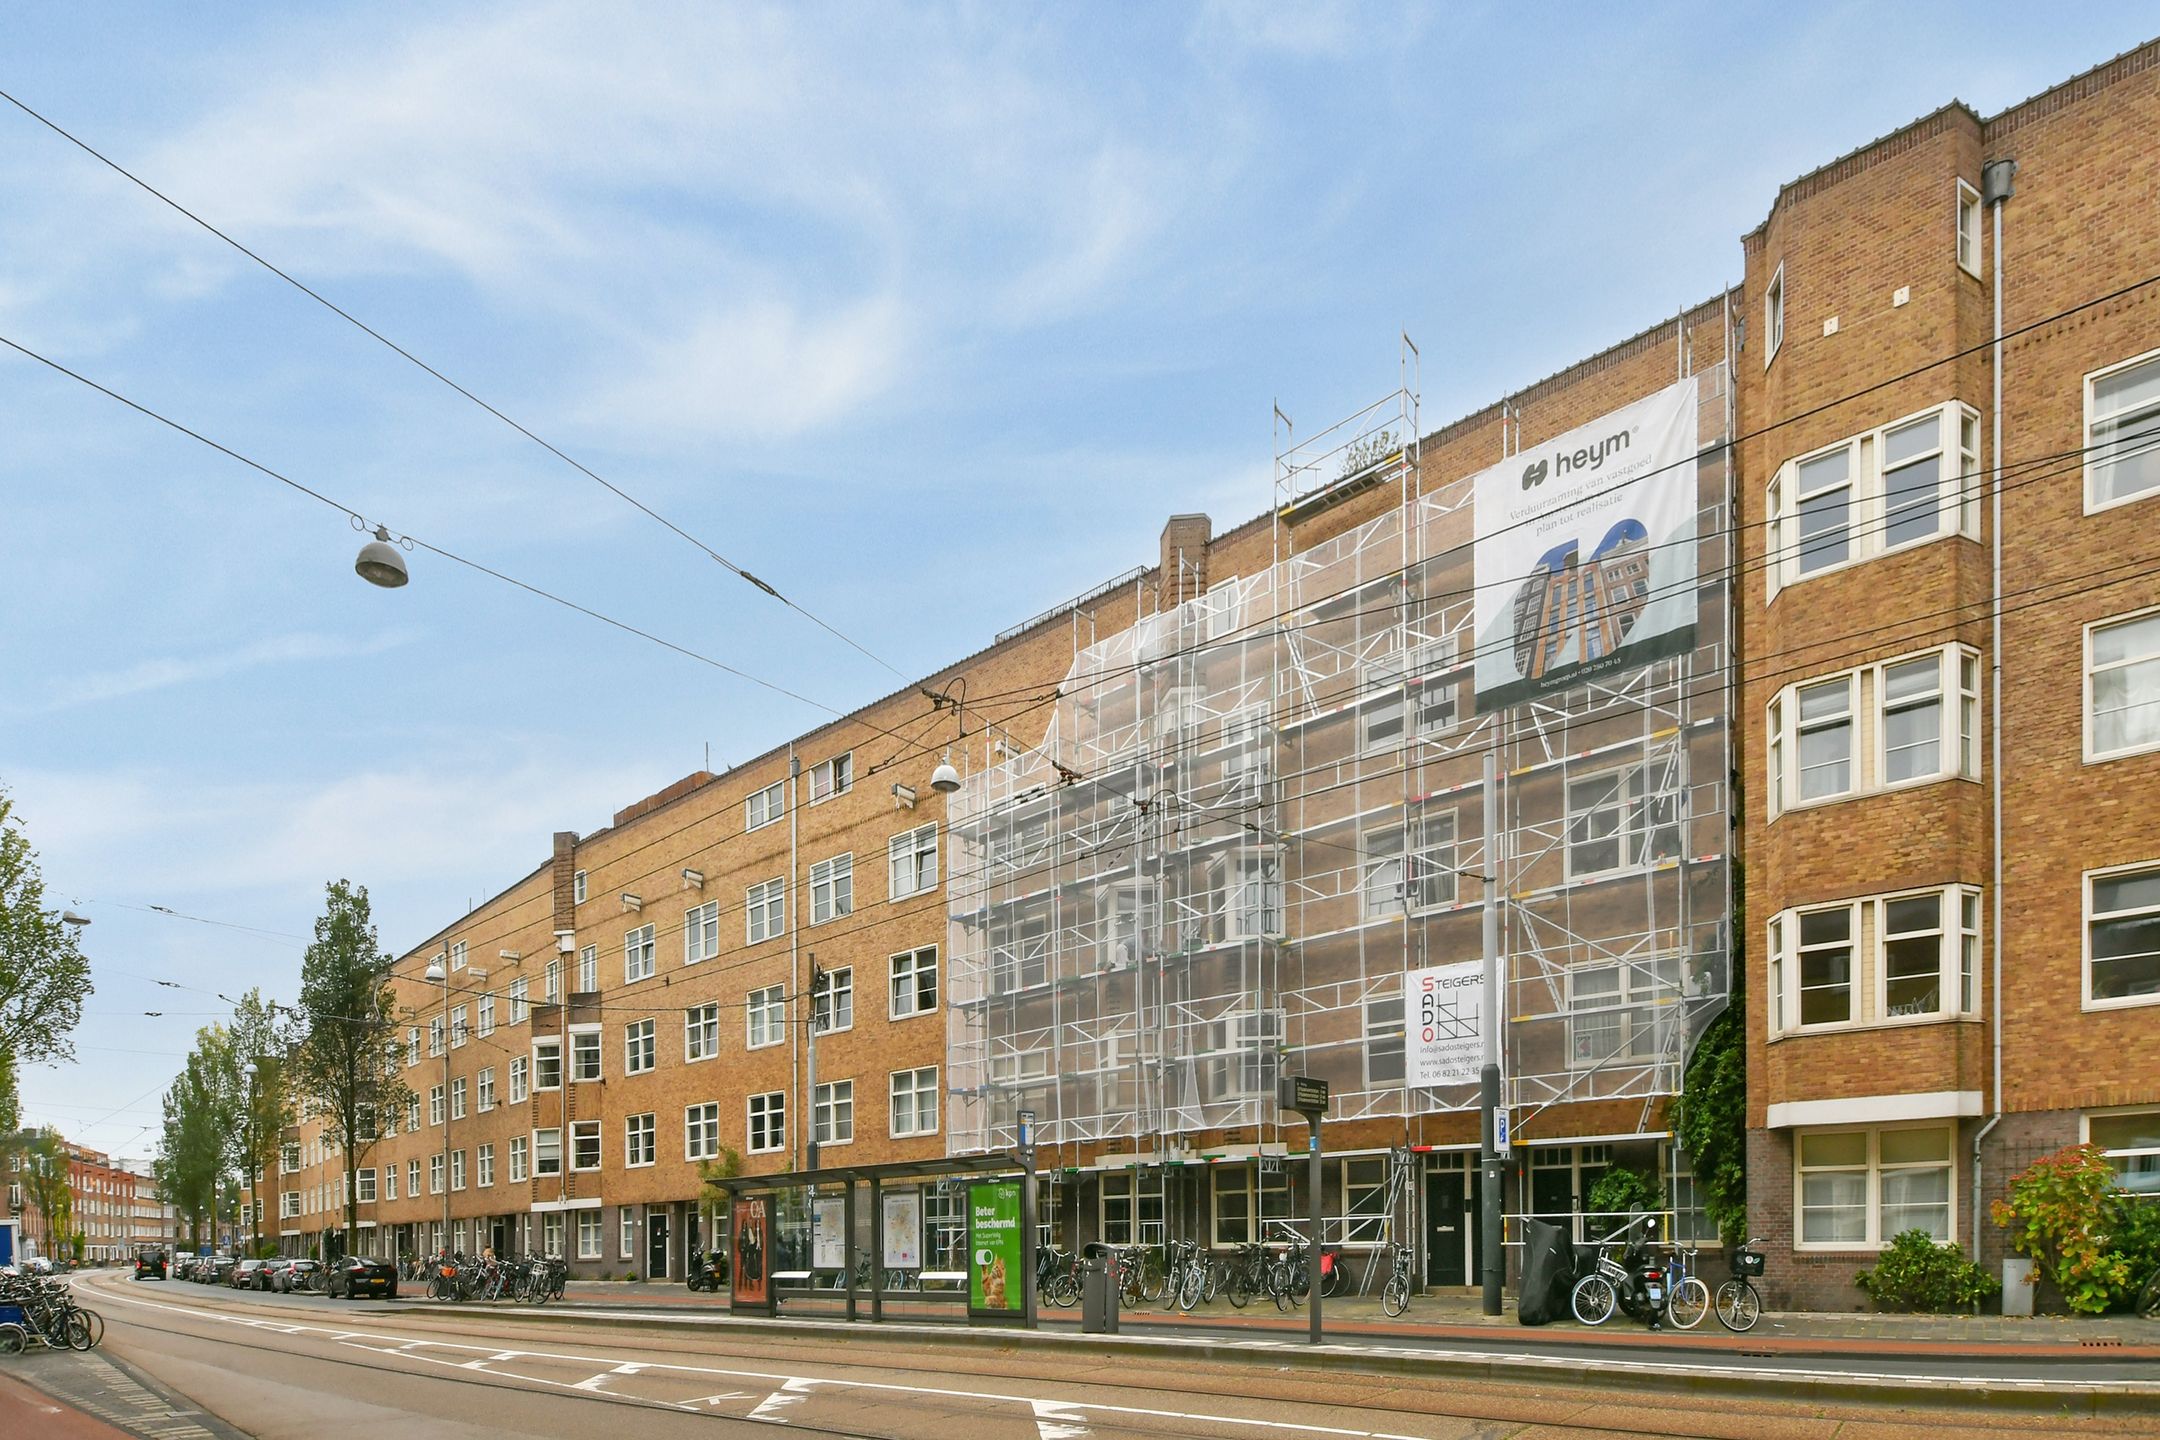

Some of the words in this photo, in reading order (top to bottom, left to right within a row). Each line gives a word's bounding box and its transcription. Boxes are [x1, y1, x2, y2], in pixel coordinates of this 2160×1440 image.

[1556, 430, 1630, 477] heym
[1510, 486, 1583, 520] Verduurzaming
[1586, 477, 1604, 490] van
[1607, 454, 1652, 480] vastgoed
[1536, 521, 1557, 537] plan
[1560, 513, 1574, 525] tot
[1577, 493, 1623, 518] realisatie
[1432, 1070, 1441, 1078] 06
[1452, 1068, 1459, 1076] 21
[1461, 1067, 1470, 1075] 22
[1005, 1189, 1016, 1198] kpn
[975, 1206, 996, 1217] Beter
[975, 1217, 1016, 1229] beschermd
